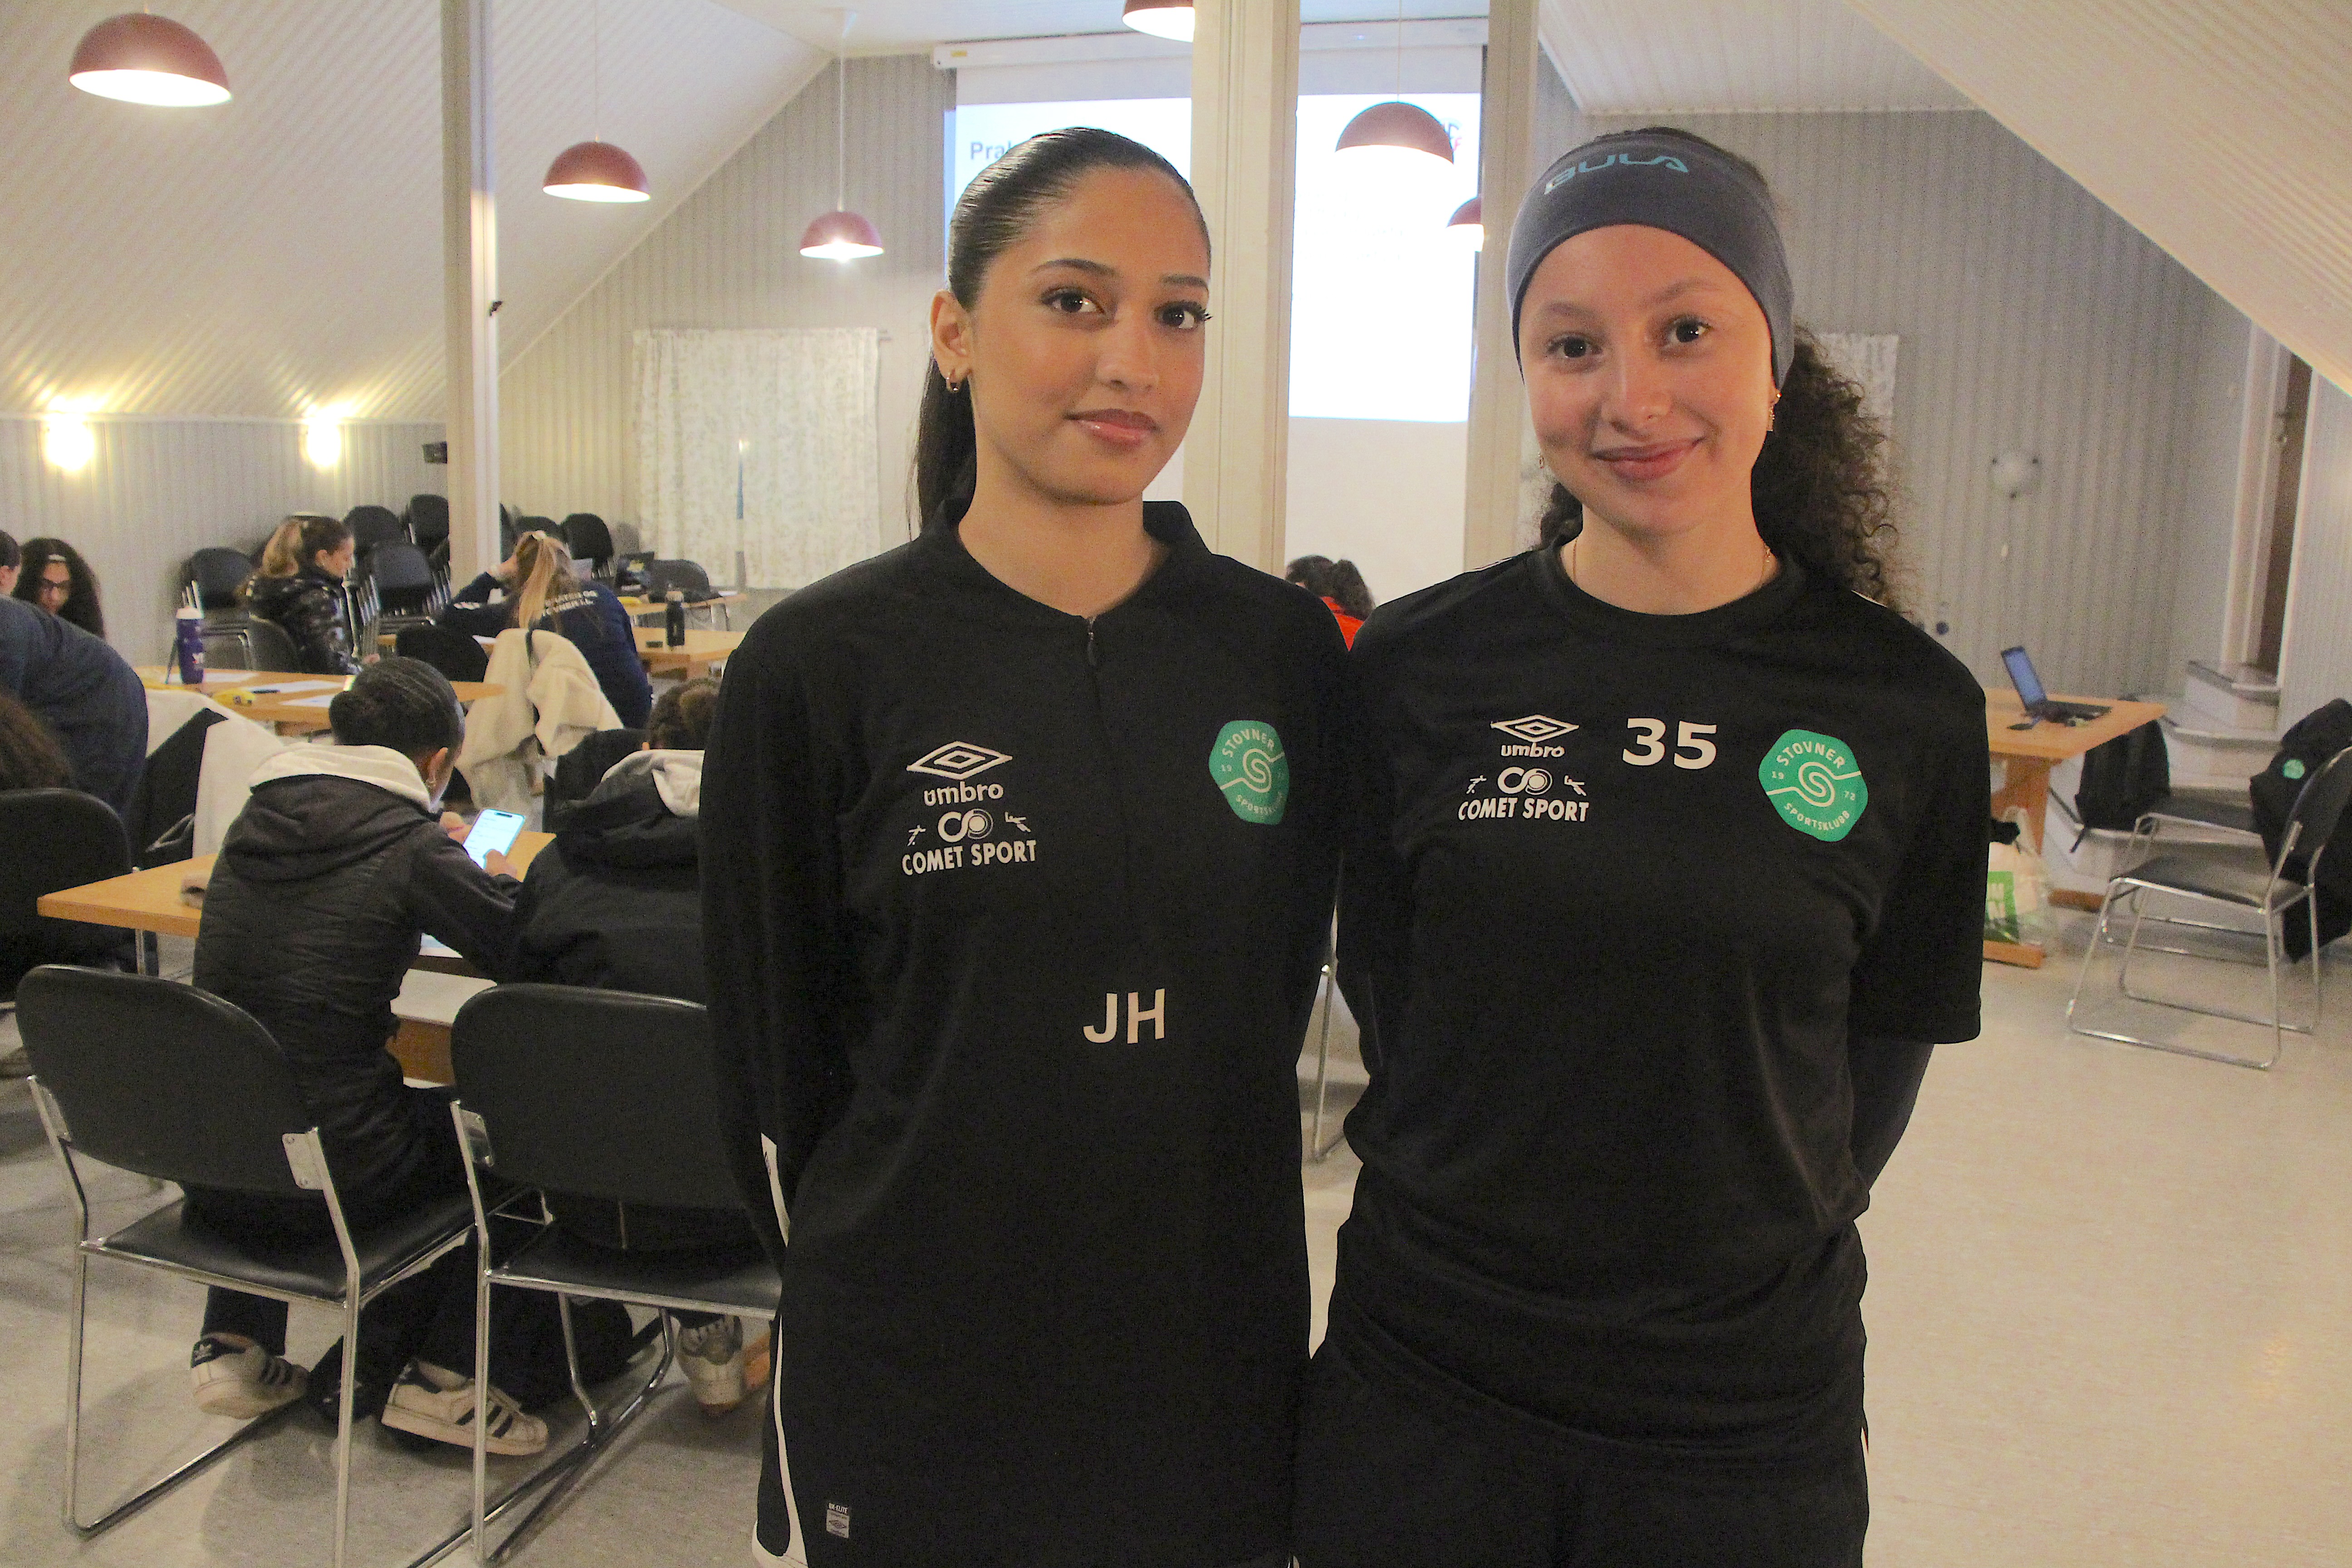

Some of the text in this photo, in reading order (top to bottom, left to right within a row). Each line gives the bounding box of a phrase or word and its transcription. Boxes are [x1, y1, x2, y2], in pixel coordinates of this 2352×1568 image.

[1544, 153, 1689, 195] BULA
[1222, 729, 1275, 758] STOVNER
[1501, 742, 1565, 758] umbro
[1622, 718, 1717, 769] 35
[1776, 741, 1845, 769] STOVNER
[923, 781, 1004, 806] umbro
[1771, 771, 1856, 801] 19 72
[1458, 797, 1589, 822] COMET SPORT
[1784, 803, 1850, 831] SPORTSKLUBB
[902, 840, 1036, 876] COMET SPORT
[1083, 988, 1166, 1044] JH
